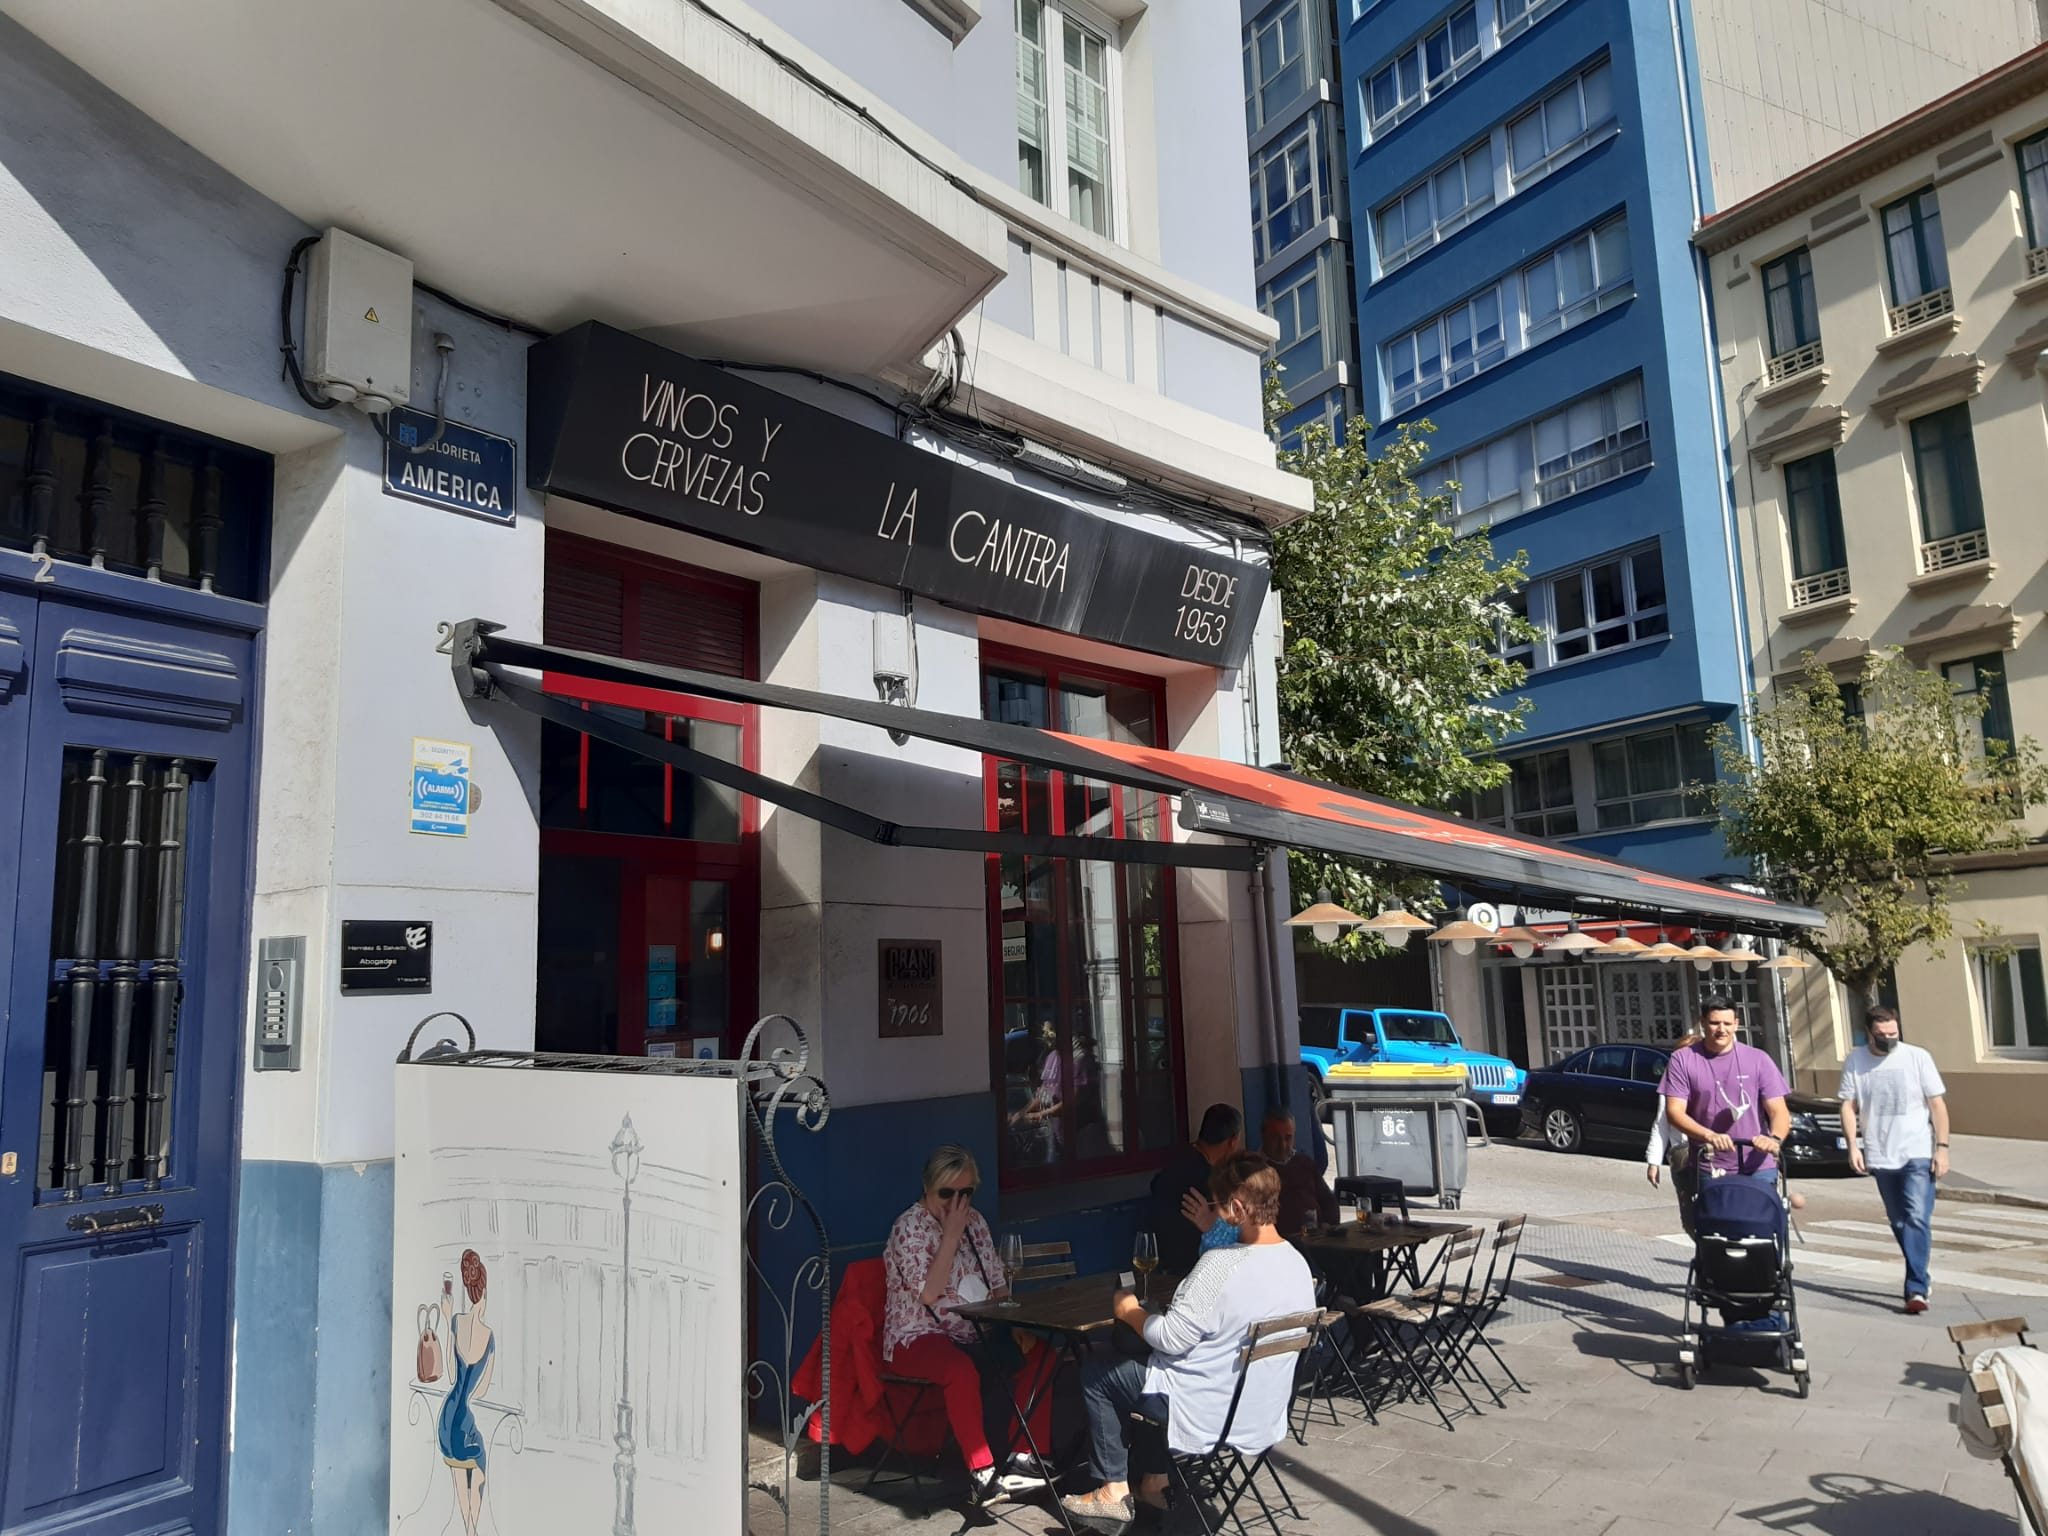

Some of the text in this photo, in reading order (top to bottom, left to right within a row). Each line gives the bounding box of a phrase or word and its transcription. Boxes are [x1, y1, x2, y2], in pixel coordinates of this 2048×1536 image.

[643, 374, 783, 463] VINOS Y
[401, 462, 502, 511] AMERICA
[622, 433, 770, 515] CERVEZAS
[877, 482, 1070, 593] LA CANTERA
[32, 553, 55, 582] 2
[1181, 565, 1239, 608] DESDE
[436, 621, 455, 655] 2
[1174, 605, 1226, 646] 1953
[427, 784, 455, 795] ALARMA
[889, 1001, 930, 1026] 1906
